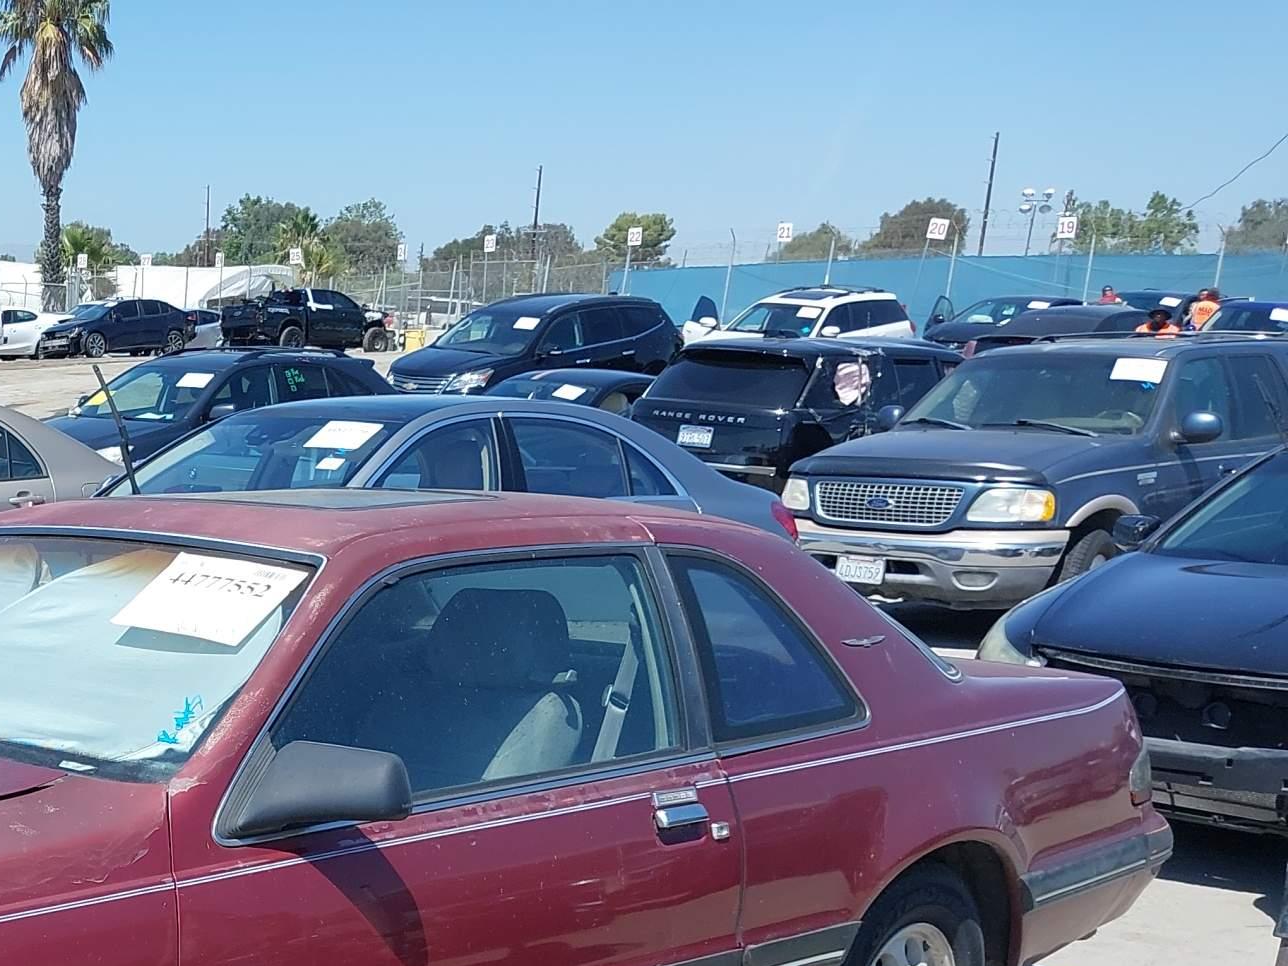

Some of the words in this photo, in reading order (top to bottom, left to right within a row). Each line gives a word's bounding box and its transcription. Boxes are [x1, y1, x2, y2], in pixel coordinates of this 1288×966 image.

[778, 226, 791, 239] 21
[929, 222, 946, 236] 20
[1058, 220, 1075, 234] 19
[485, 238, 495, 249] 23
[629, 231, 641, 243] 22
[290, 251, 300, 263] 25
[653, 409, 692, 419] RANGE
[698, 414, 745, 423] ROVER
[168, 571, 273, 598] 44777552
